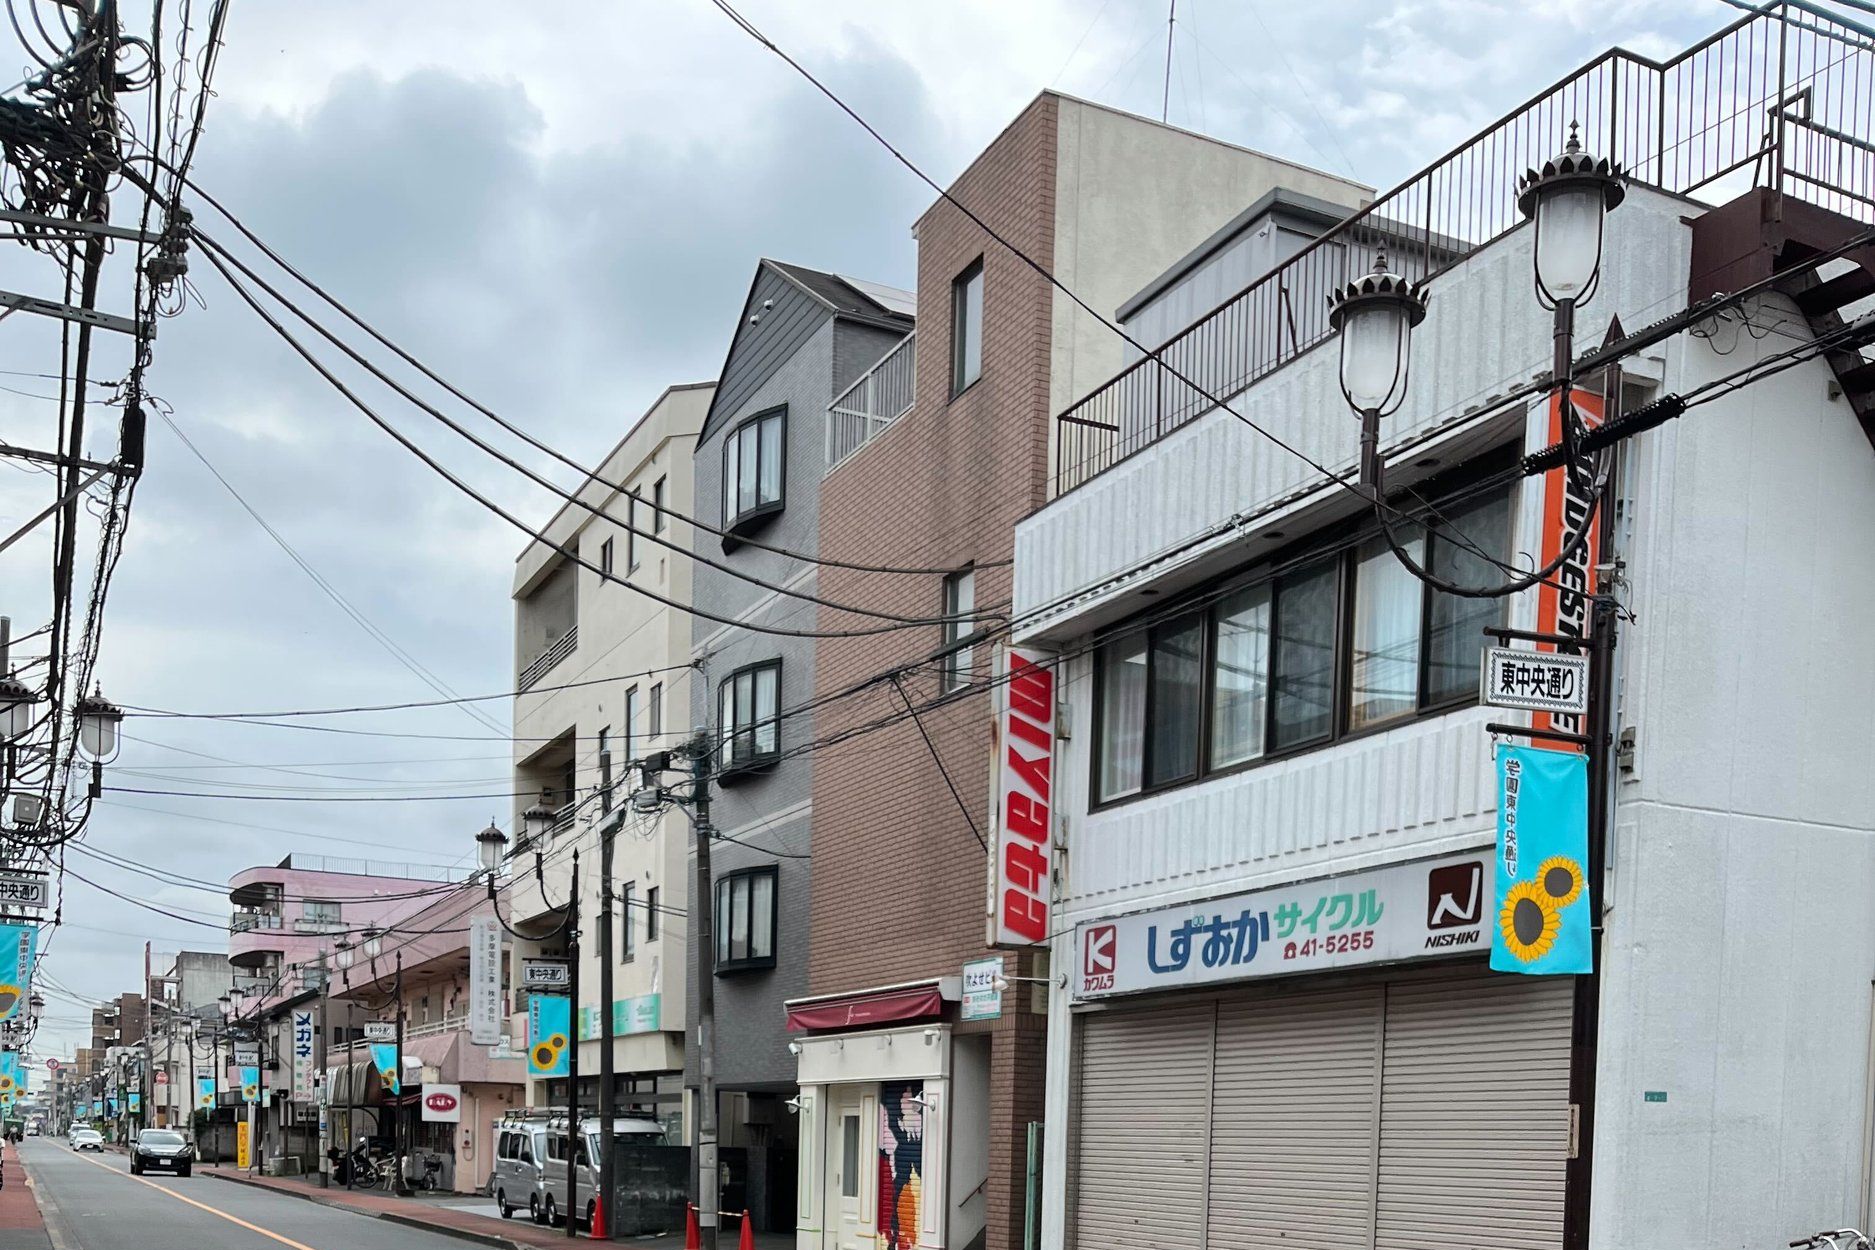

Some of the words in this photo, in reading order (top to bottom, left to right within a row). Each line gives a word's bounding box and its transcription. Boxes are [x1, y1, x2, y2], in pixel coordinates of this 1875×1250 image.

[1500, 660, 1574, 700] 東中央通り
[1300, 930, 1375, 957] 41-5255
[1424, 930, 1480, 949] NISHIKI
[528, 968, 562, 981] 東中央通り
[1083, 974, 1115, 992] カワムラ
[295, 1012, 312, 1058] メガネ
